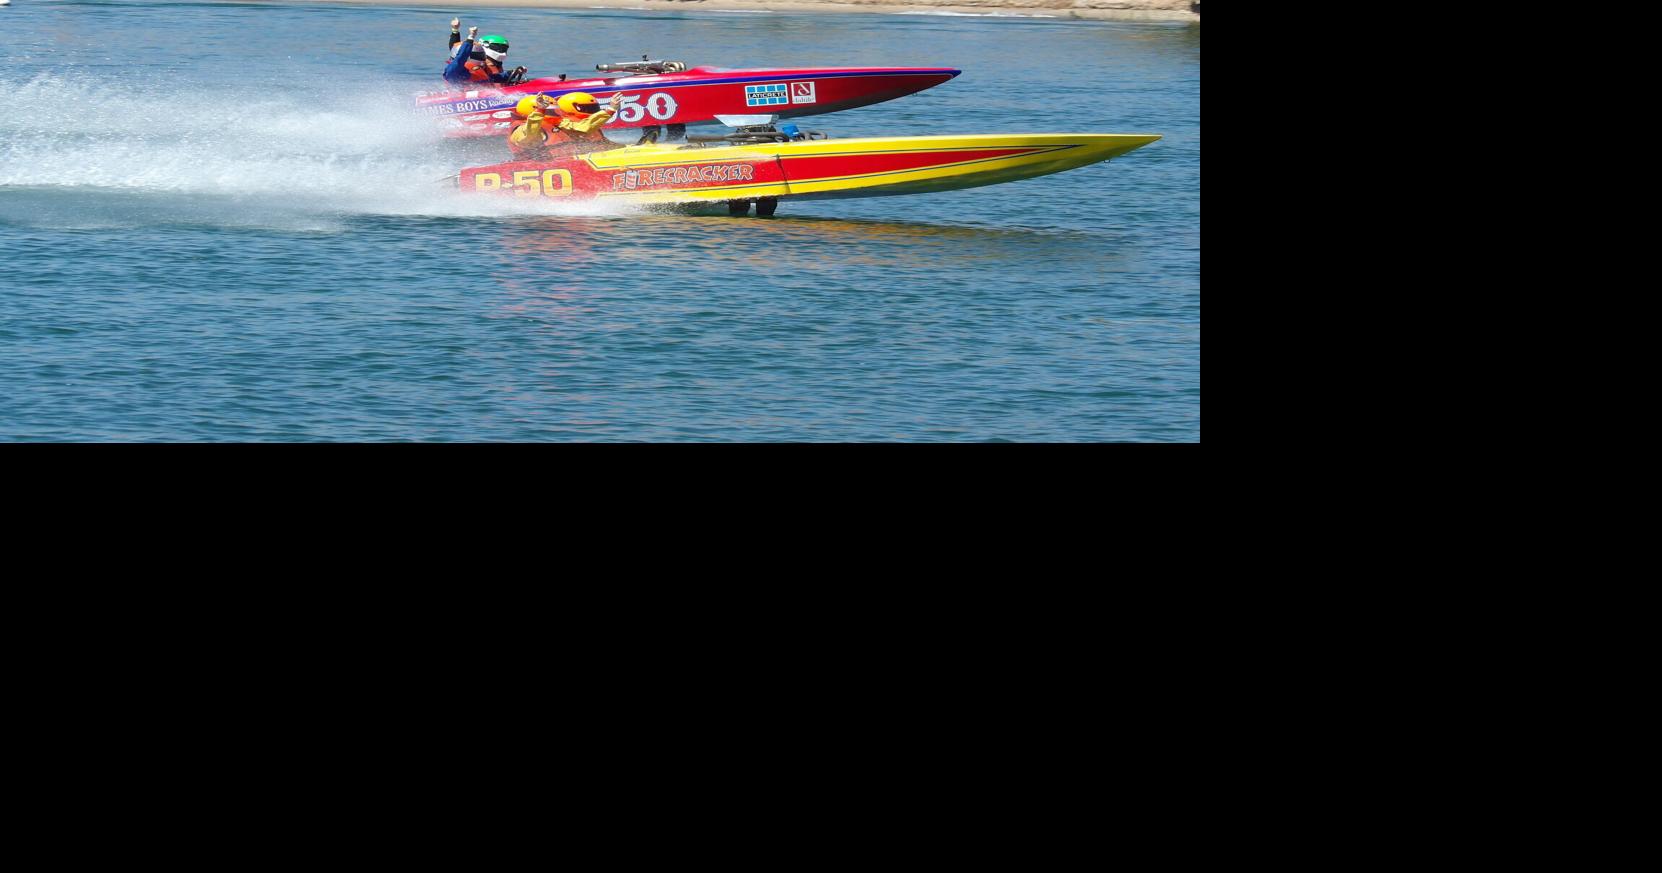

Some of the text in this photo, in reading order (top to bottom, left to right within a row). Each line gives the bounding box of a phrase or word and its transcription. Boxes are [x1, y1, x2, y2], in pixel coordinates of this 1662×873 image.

[748, 91, 785, 99] LATICRETE
[456, 99, 488, 113] BOYS
[613, 164, 754, 190] FIRECRACKER
